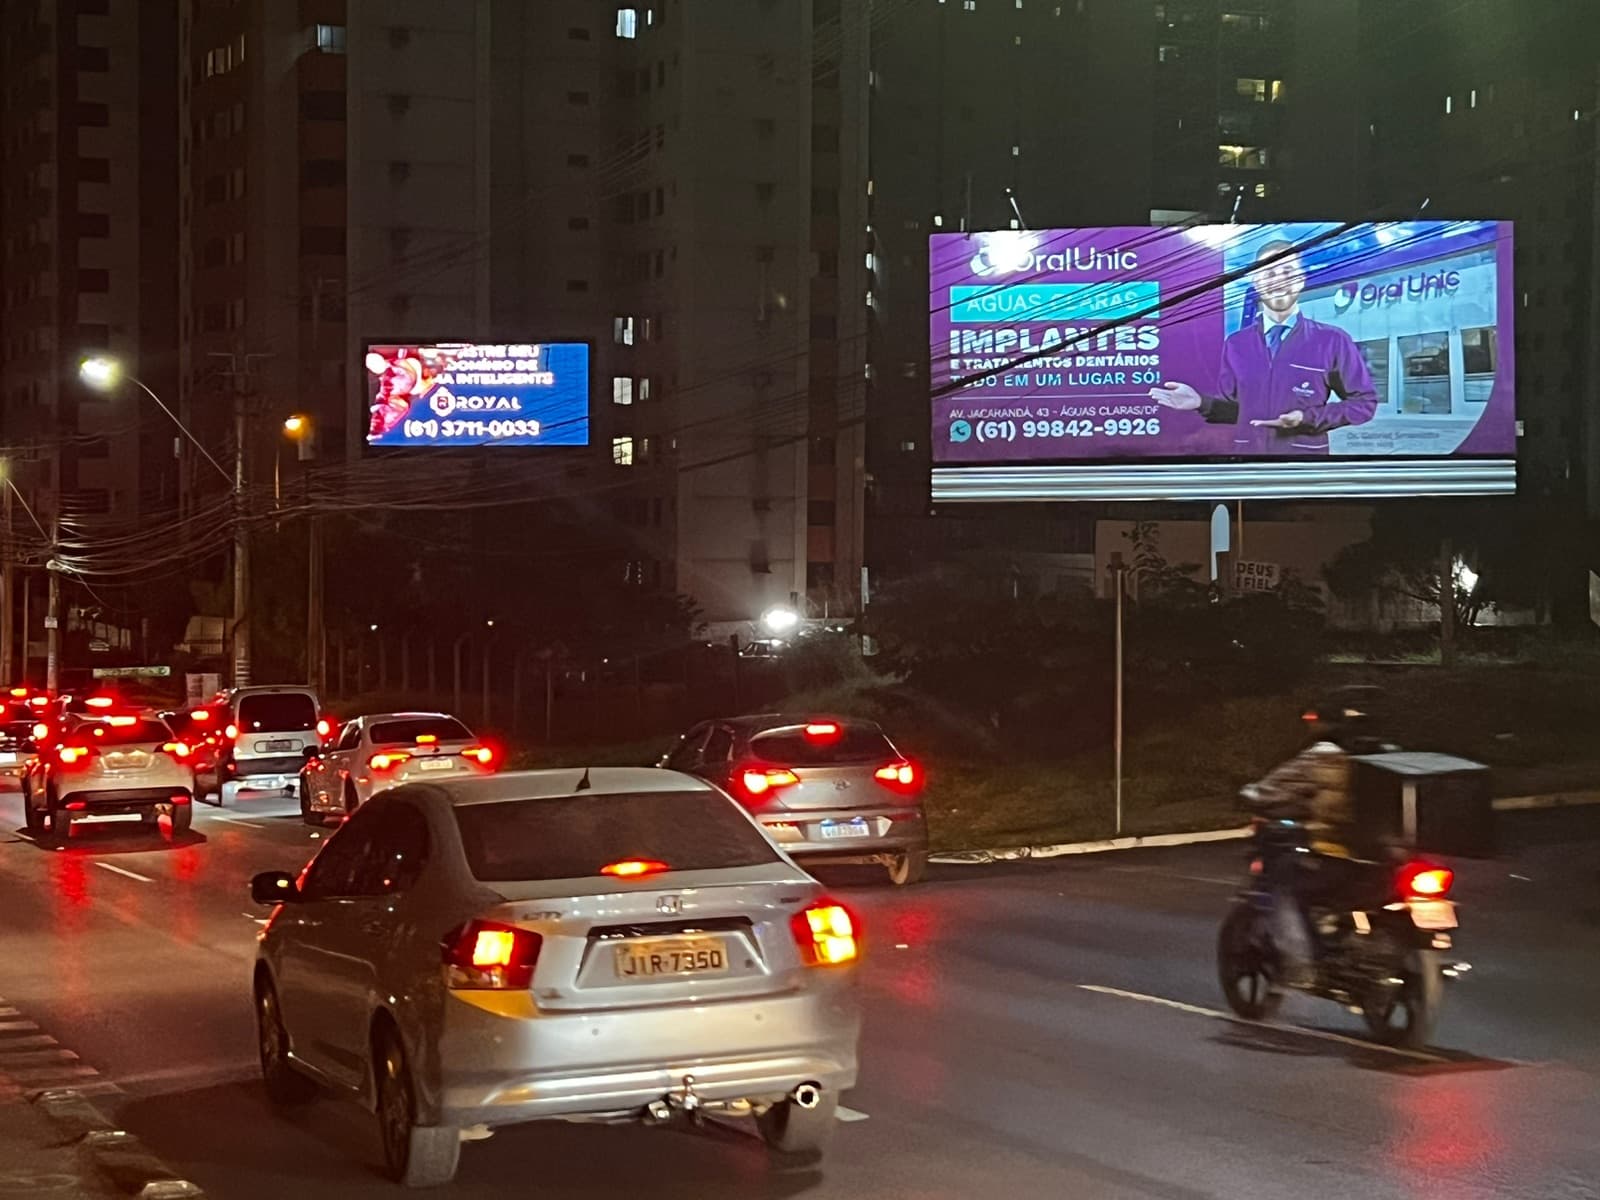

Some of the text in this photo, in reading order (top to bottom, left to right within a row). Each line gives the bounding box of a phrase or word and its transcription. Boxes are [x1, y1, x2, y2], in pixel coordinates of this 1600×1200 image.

[950, 325, 1160, 354] IMPLANTES
[950, 353, 1160, 370] E TRATAENTOS DENTÁRIOS
[950, 368, 1161, 387] TDO EM UM LUGAR SÓ!
[456, 396, 522, 409] ROYAL
[976, 418, 1160, 442] (61) 99842-9926
[1236, 562, 1275, 578] DEUS
